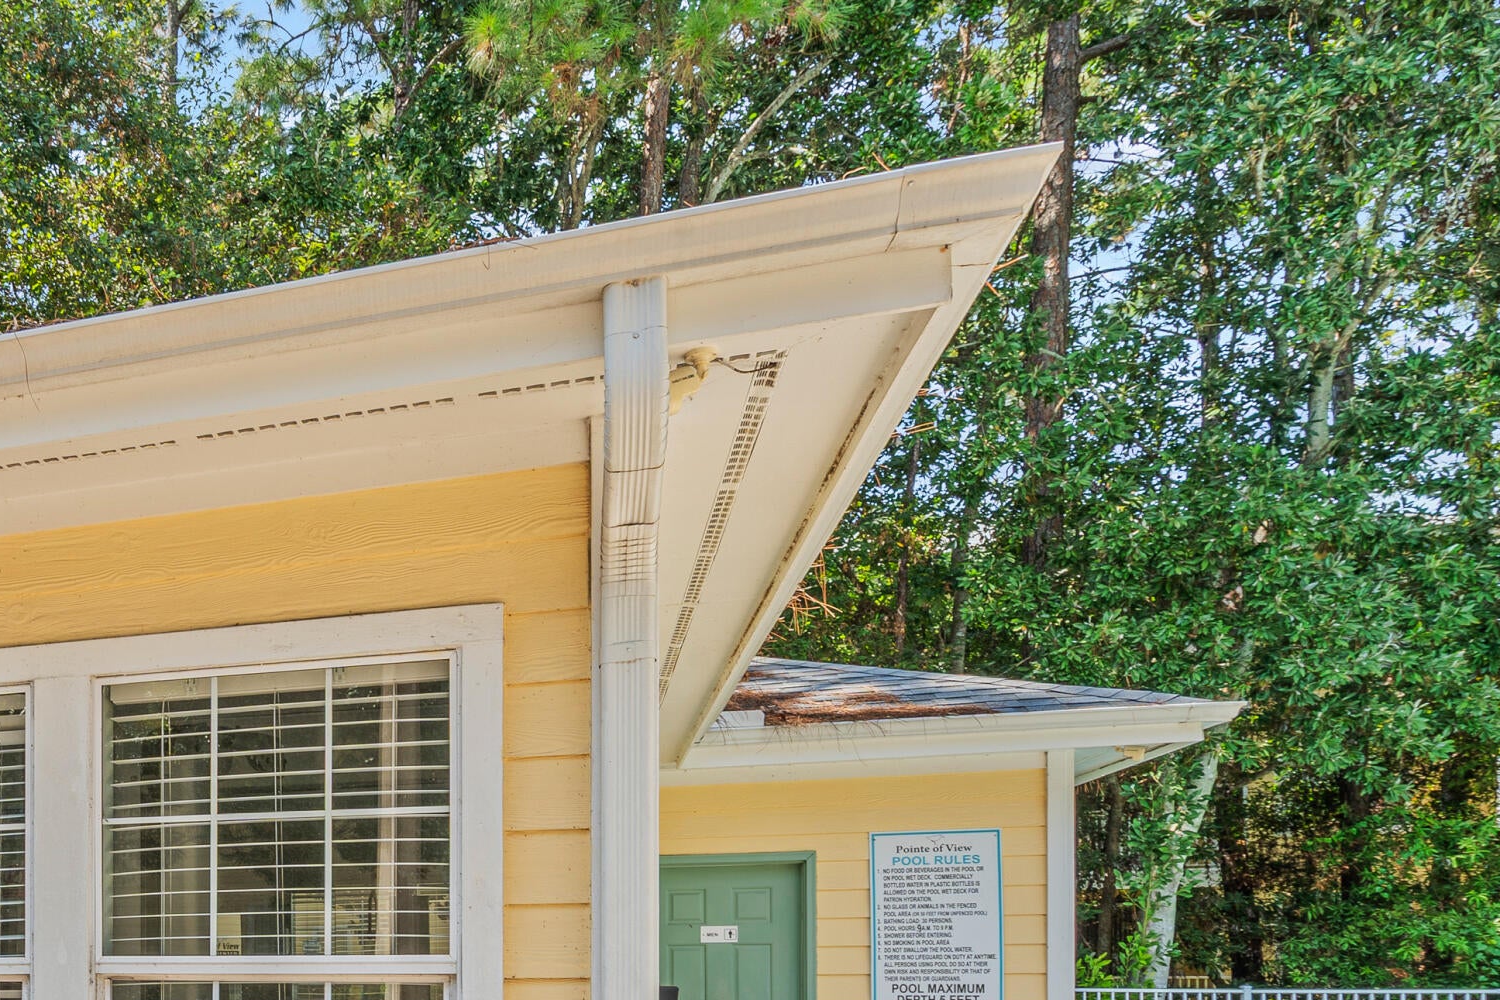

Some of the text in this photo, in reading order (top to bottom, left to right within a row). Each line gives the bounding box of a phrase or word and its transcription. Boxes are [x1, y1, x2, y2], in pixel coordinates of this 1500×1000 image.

[896, 844, 972, 854] Pointe of View
[892, 855, 980, 865] POOL RULES
[892, 984, 985, 993] POOL MAXIMUM
